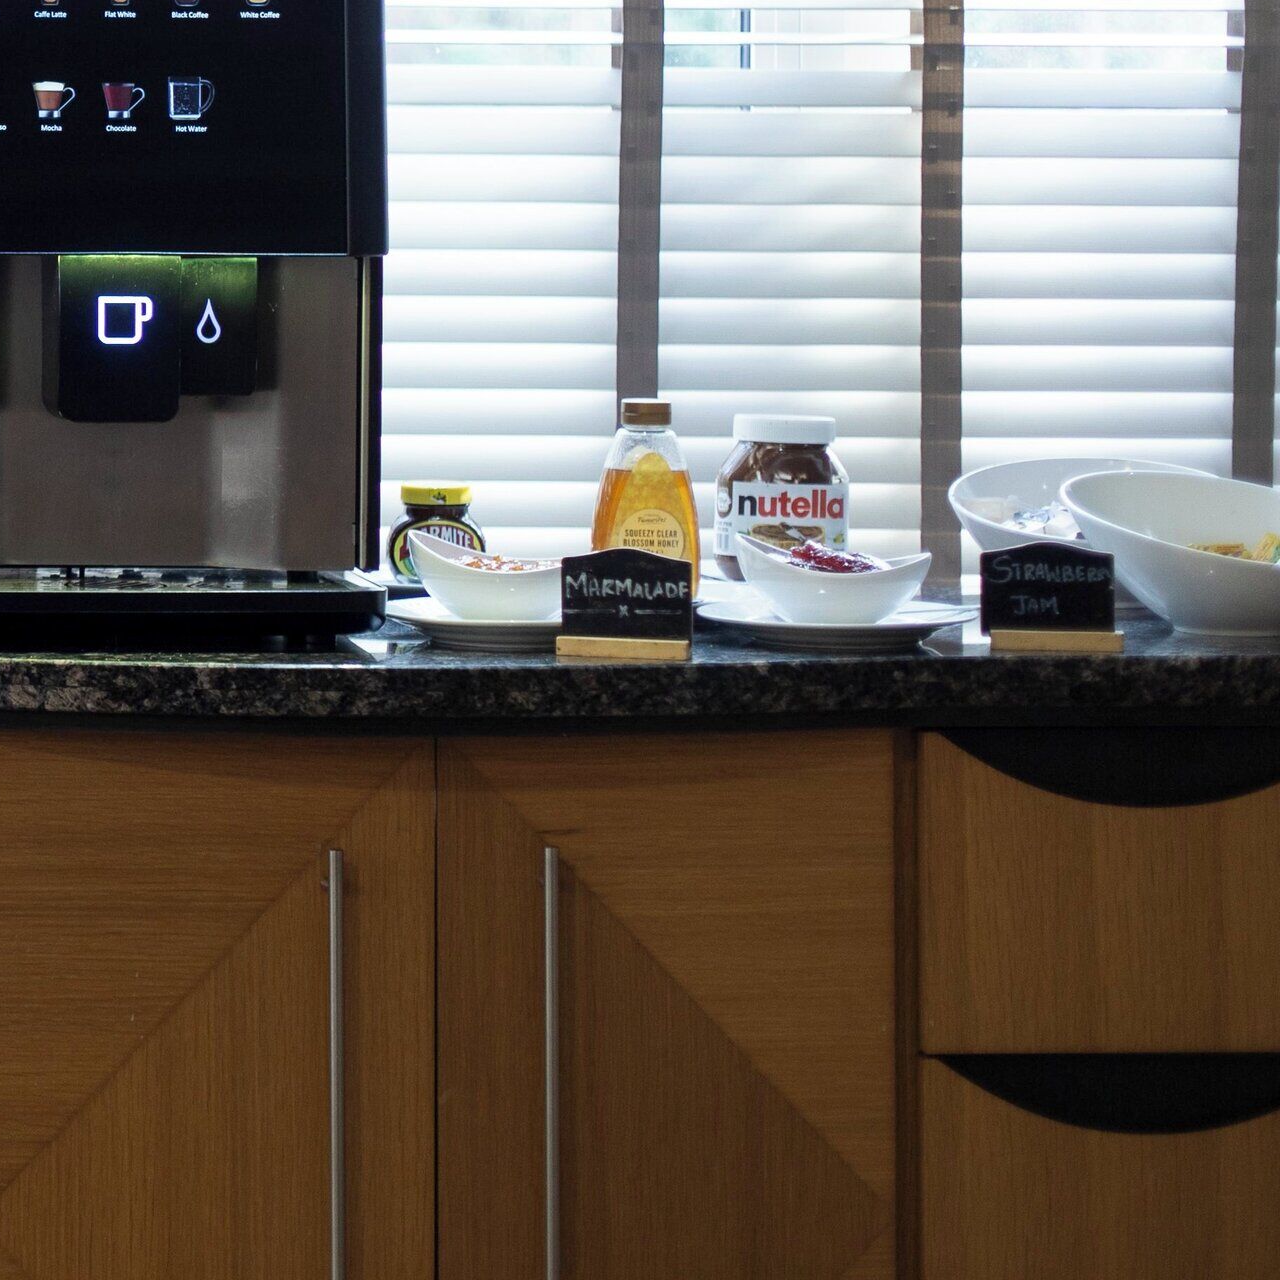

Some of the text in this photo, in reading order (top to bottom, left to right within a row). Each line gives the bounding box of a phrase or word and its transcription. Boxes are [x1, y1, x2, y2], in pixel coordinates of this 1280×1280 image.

[738, 490, 844, 519] nutella
[625, 529, 678, 538] SQUEEZY CLEAR
[623, 538, 679, 548] BLOSSOM HONEY
[1010, 595, 1060, 615] JAM
